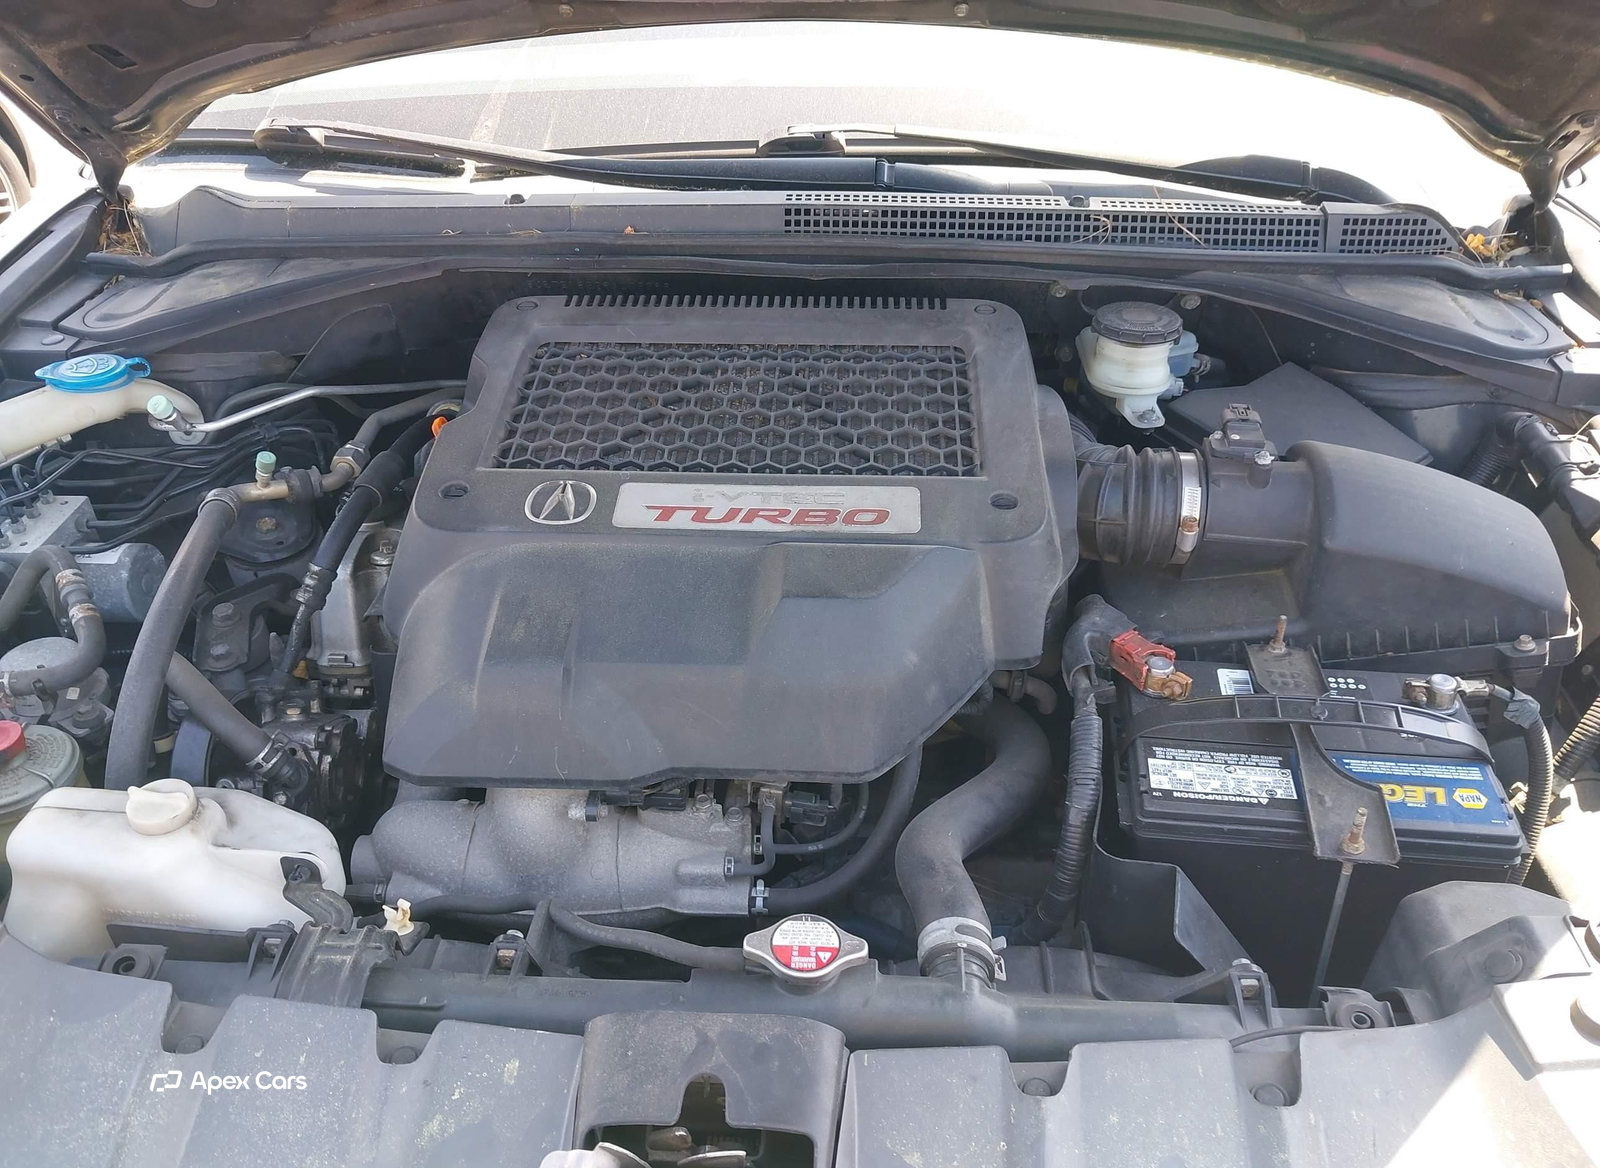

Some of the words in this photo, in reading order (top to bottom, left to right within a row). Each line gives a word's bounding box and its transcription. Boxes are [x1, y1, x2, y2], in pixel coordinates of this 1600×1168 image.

[643, 504, 891, 526] TURBO
[1172, 791, 1258, 803] DANGER/POISON
[1458, 794, 1481, 803] NAPA
